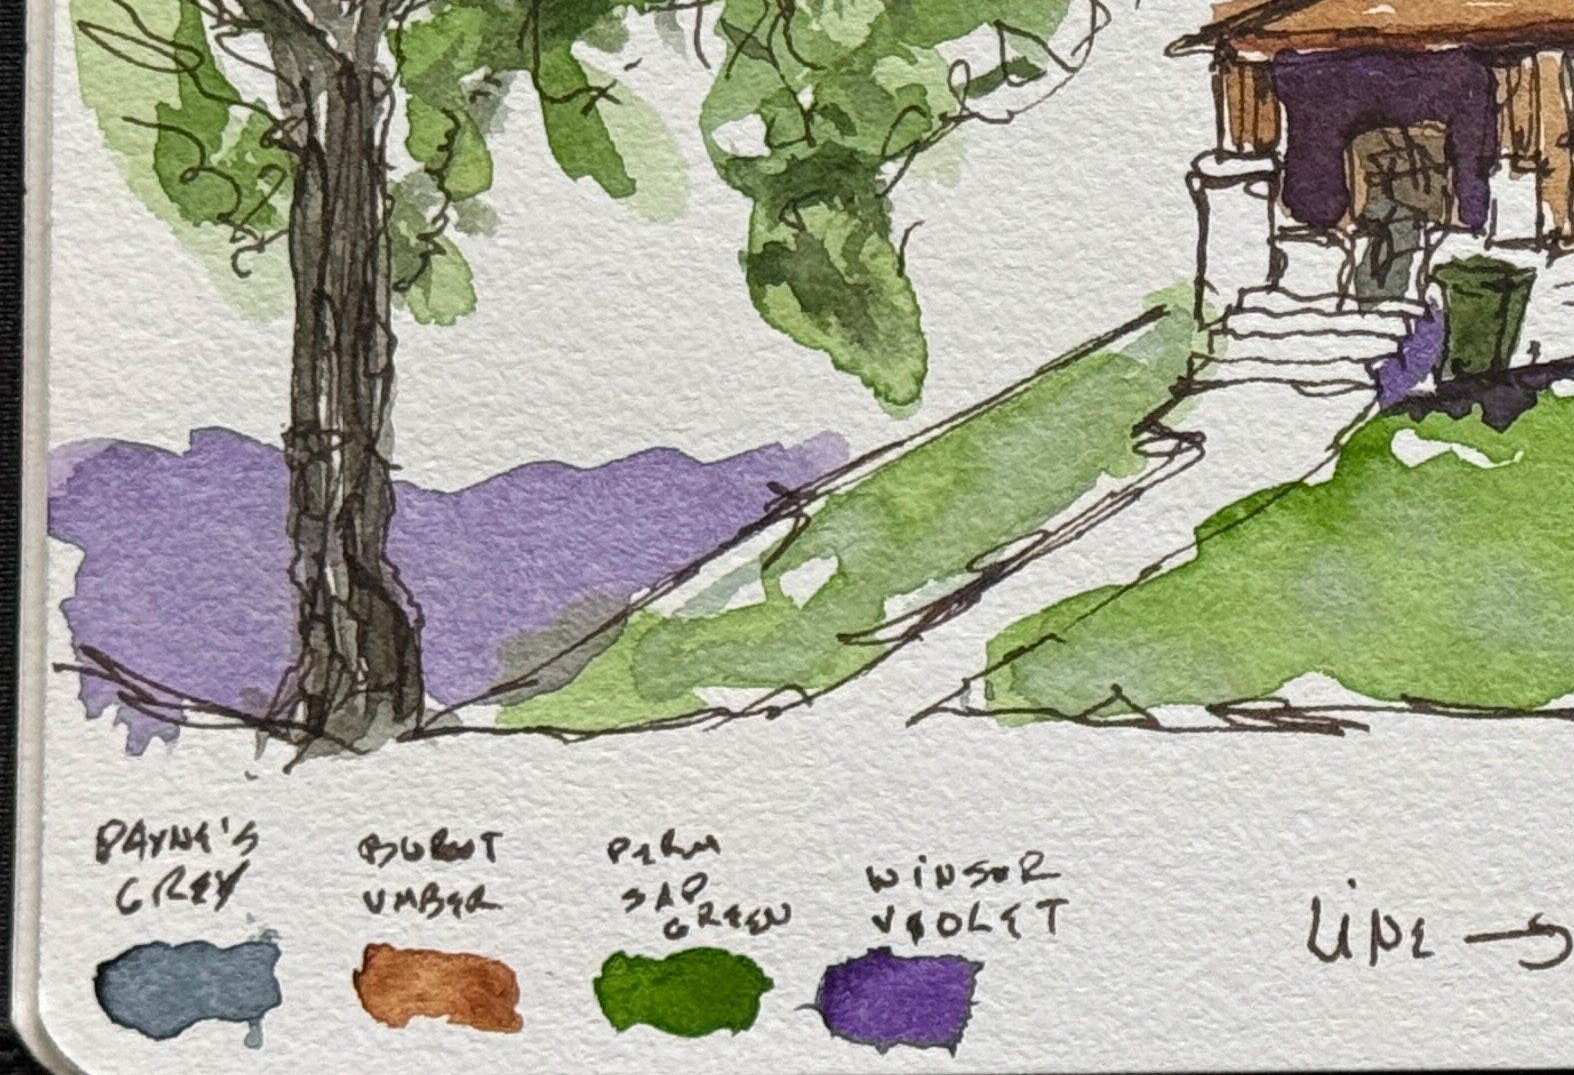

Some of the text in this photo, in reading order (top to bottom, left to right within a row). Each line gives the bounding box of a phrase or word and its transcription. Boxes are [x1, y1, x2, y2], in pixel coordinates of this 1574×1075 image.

[115, 858, 251, 916] GREY
[362, 882, 501, 920] UMBER
[621, 871, 708, 913] SAP
[662, 900, 793, 941] GREEN
